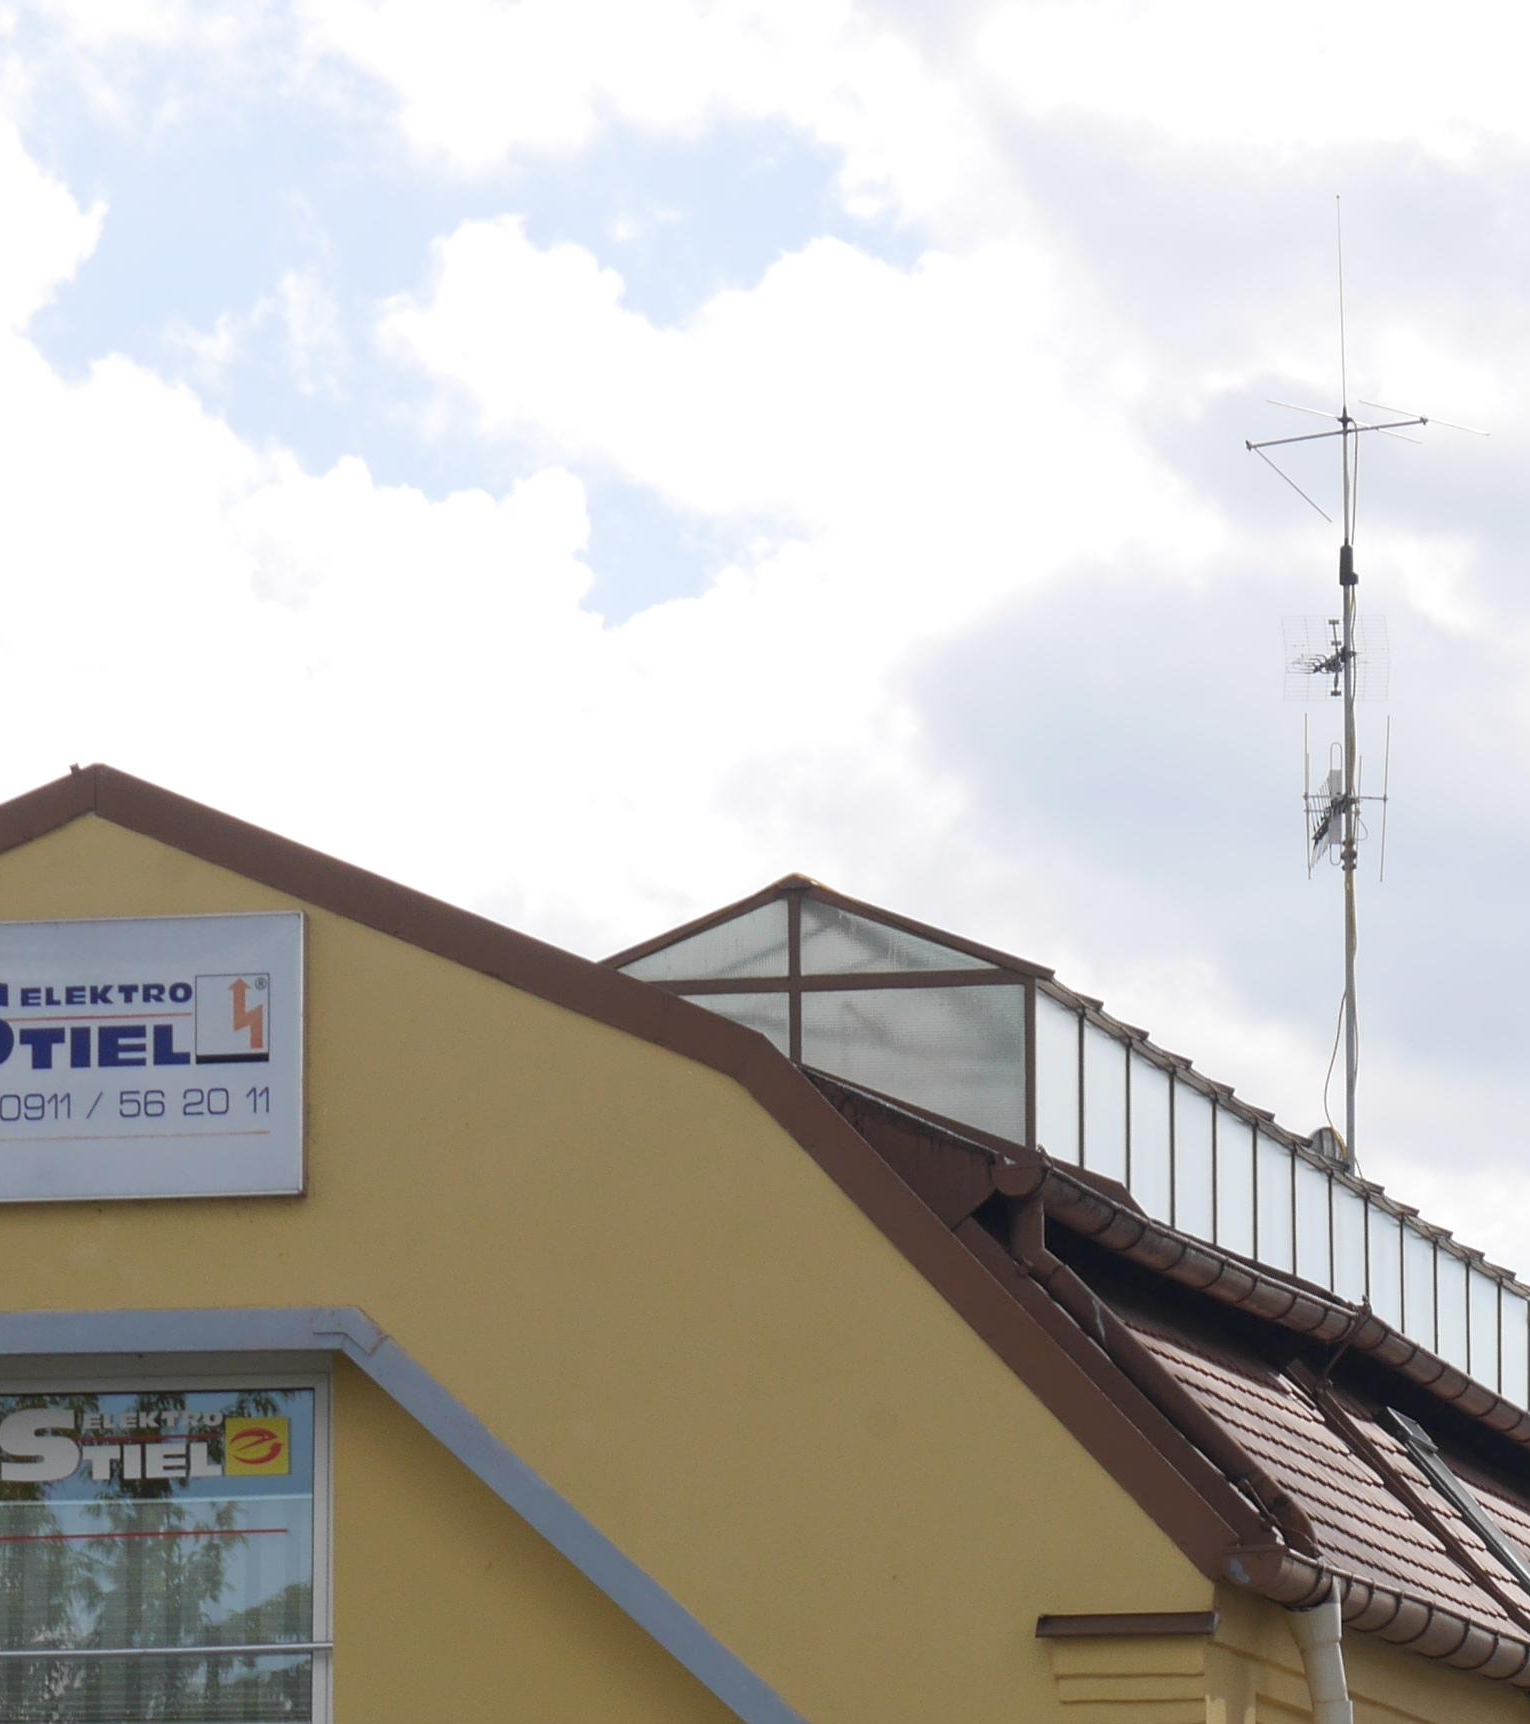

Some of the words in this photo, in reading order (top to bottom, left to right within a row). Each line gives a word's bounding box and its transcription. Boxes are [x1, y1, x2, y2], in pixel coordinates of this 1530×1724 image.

[20, 982, 193, 1007] ELEKTRO
[0, 1093, 71, 1122] 0911
[86, 1092, 104, 1119] /
[119, 1090, 166, 1118] 56
[183, 1088, 229, 1115] 20
[246, 1086, 269, 1114] 11
[82, 1409, 224, 1430] ELEKTRO
